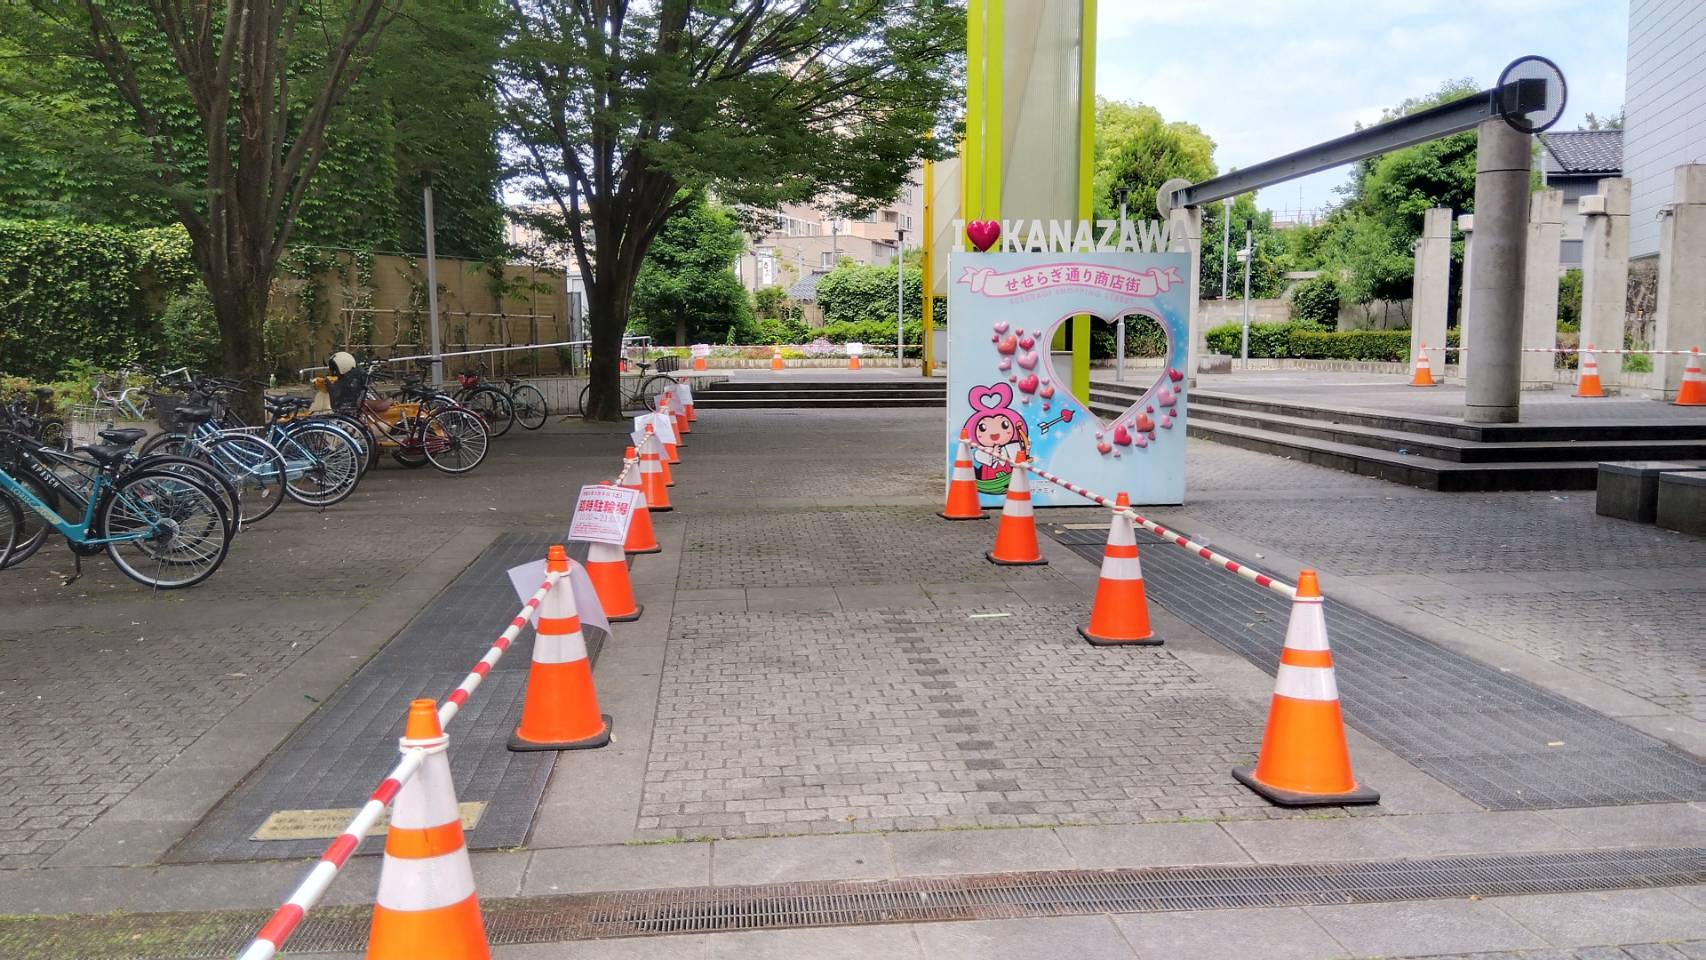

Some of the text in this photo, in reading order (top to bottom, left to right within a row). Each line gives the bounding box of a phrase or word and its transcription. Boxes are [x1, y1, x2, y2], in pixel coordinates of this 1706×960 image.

[1002, 219, 1193, 253] KANAZAWA
[1005, 267, 1141, 293] せせらぎ通り商店街
